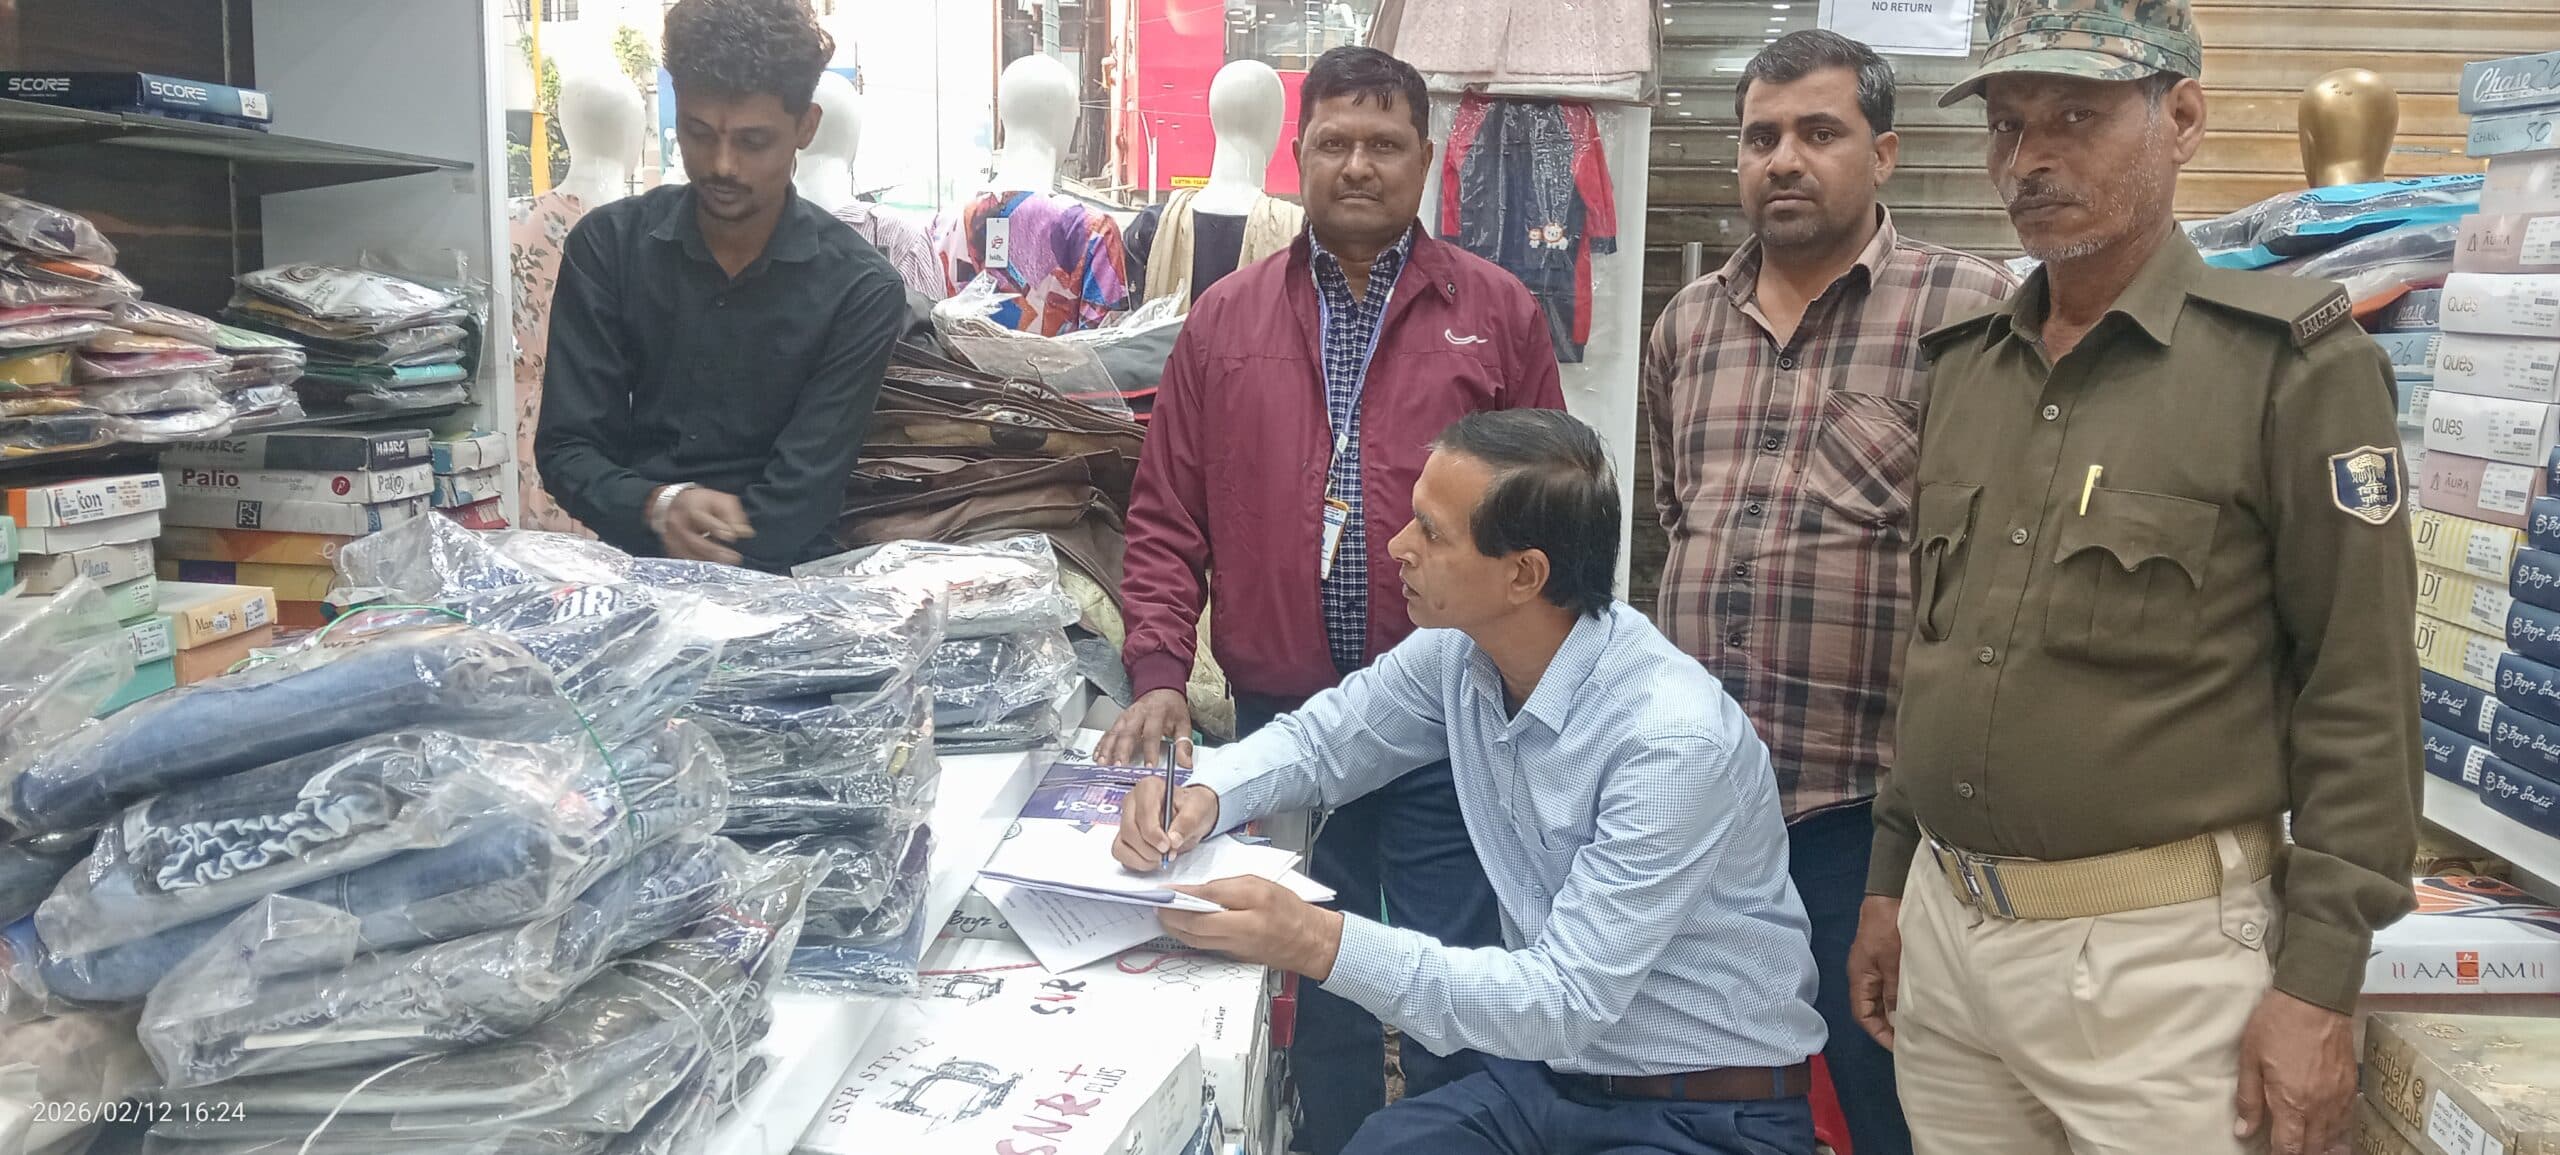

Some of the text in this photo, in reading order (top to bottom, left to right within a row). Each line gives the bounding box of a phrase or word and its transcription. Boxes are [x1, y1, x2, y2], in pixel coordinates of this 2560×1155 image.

[1872, 2, 1932, 13] NO RETURN
[8, 78, 71, 91] SCORE
[150, 82, 208, 100] SCORE
[181, 468, 240, 488] Palio
[2417, 519, 2440, 551] DJ
[2420, 573, 2442, 604] DJ
[2416, 626, 2437, 657] DJ
[1030, 978, 1087, 1015] SNR
[828, 1037, 935, 1124] SNR STYLE
[1084, 1067, 1127, 1095] PLUS
[996, 1092, 1100, 1155] SNR
